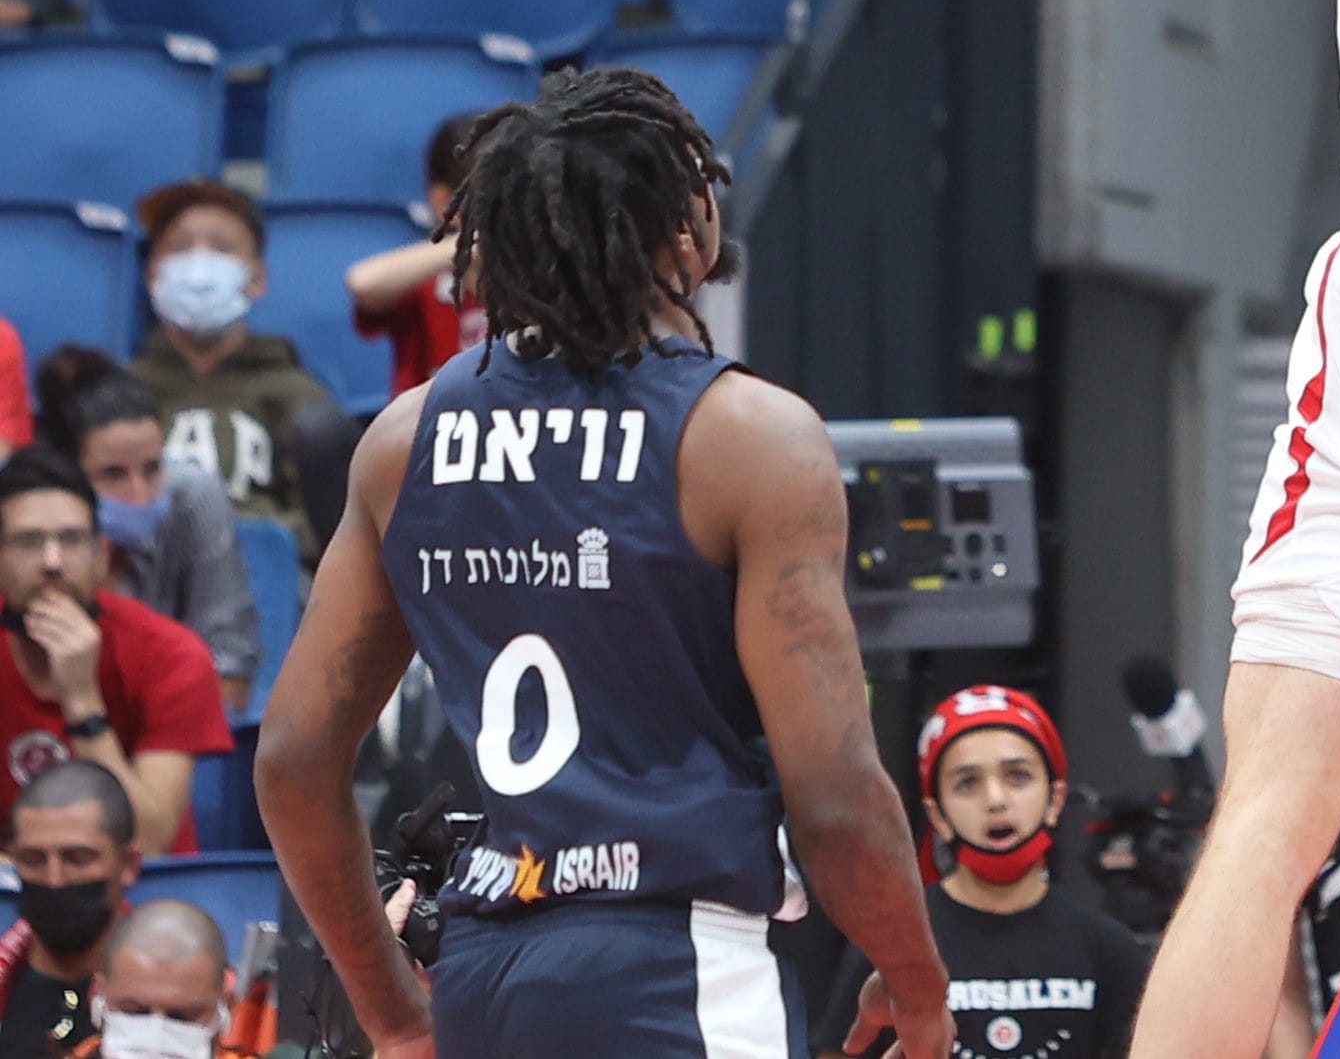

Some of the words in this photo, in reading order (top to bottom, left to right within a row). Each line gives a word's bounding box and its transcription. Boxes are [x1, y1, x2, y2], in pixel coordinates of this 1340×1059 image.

[433, 408, 646, 485] וויאט
[418, 548, 453, 595] דן
[465, 539, 572, 588] מלונות
[475, 633, 581, 796] 0
[552, 841, 641, 895] ISRAIR
[946, 978, 1097, 1011] RUSALEM
